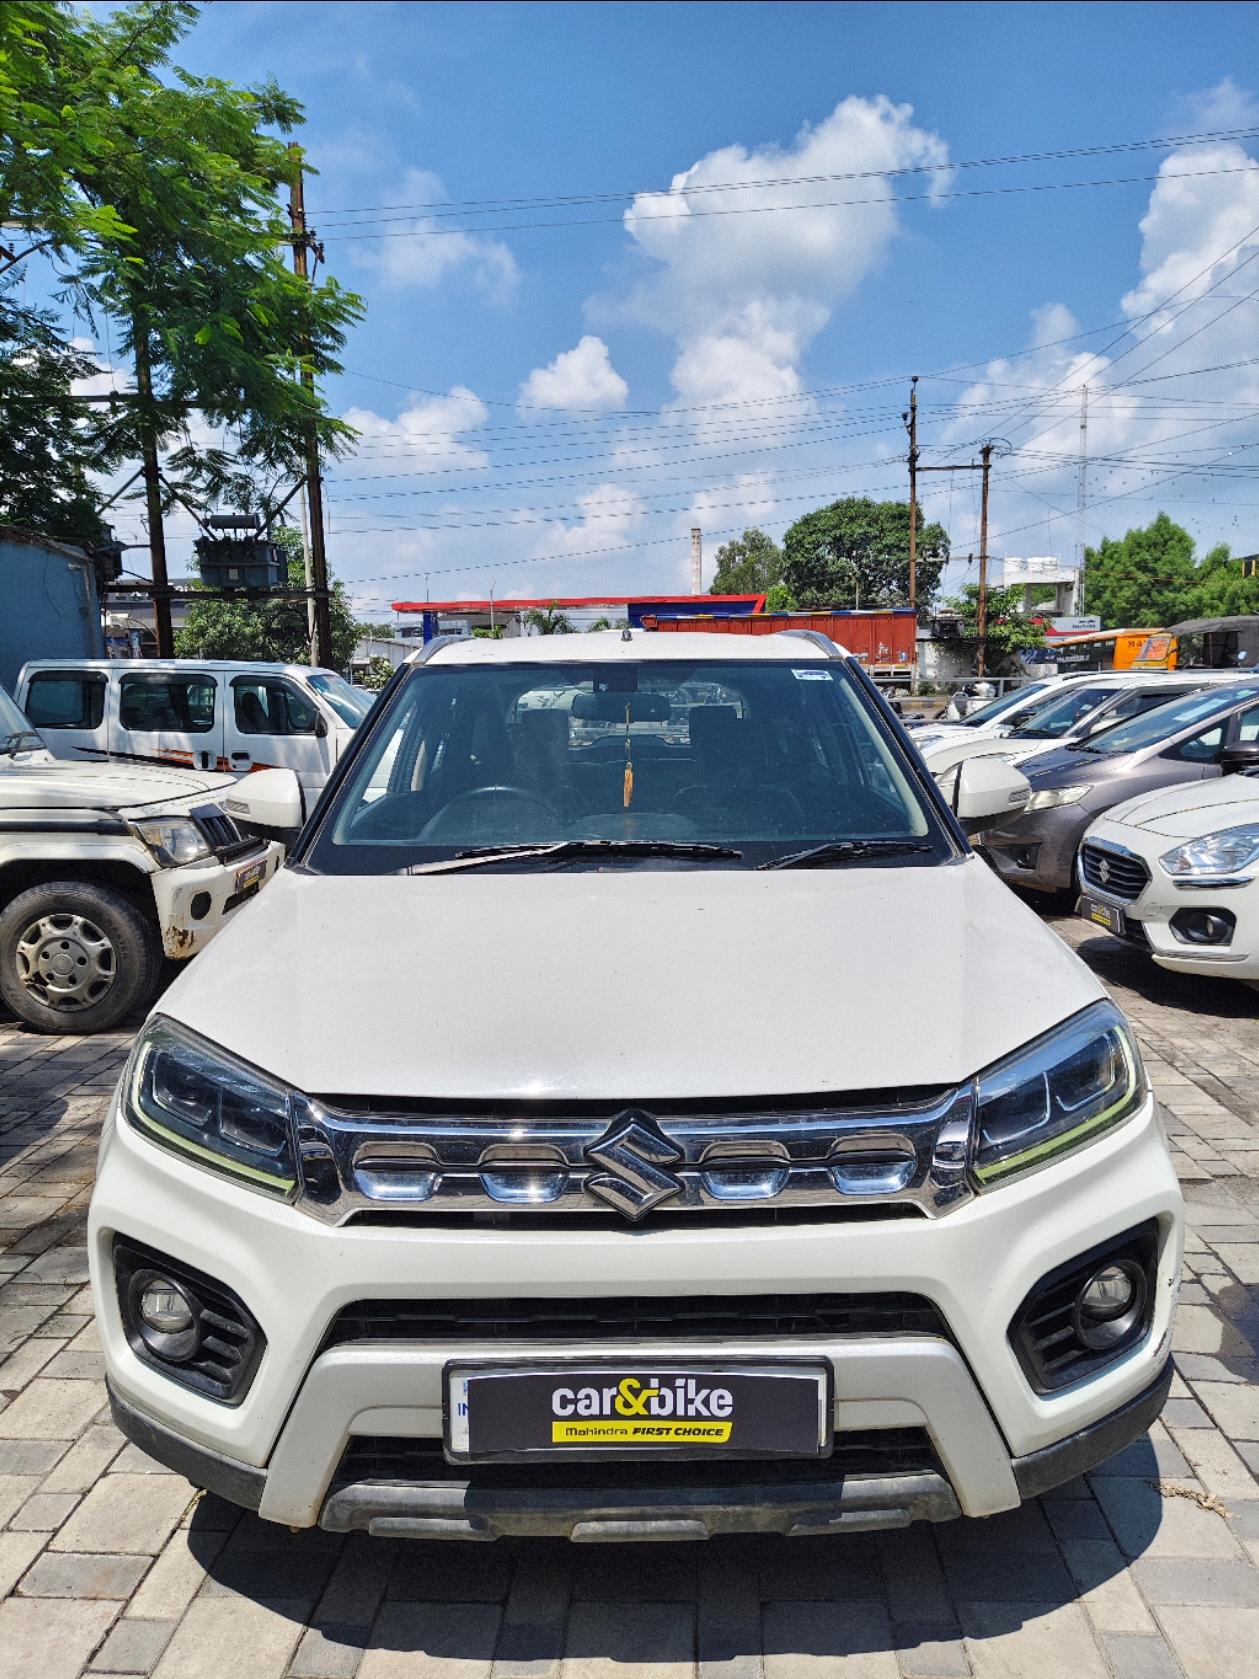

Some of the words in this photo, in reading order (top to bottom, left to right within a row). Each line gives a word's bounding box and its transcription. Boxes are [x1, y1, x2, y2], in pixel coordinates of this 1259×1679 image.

[552, 1378, 733, 1418] car&bike
[565, 1427, 628, 1436] Mahindra
[632, 1427, 673, 1436] FIRST
[673, 1428, 725, 1437] CHOICE
